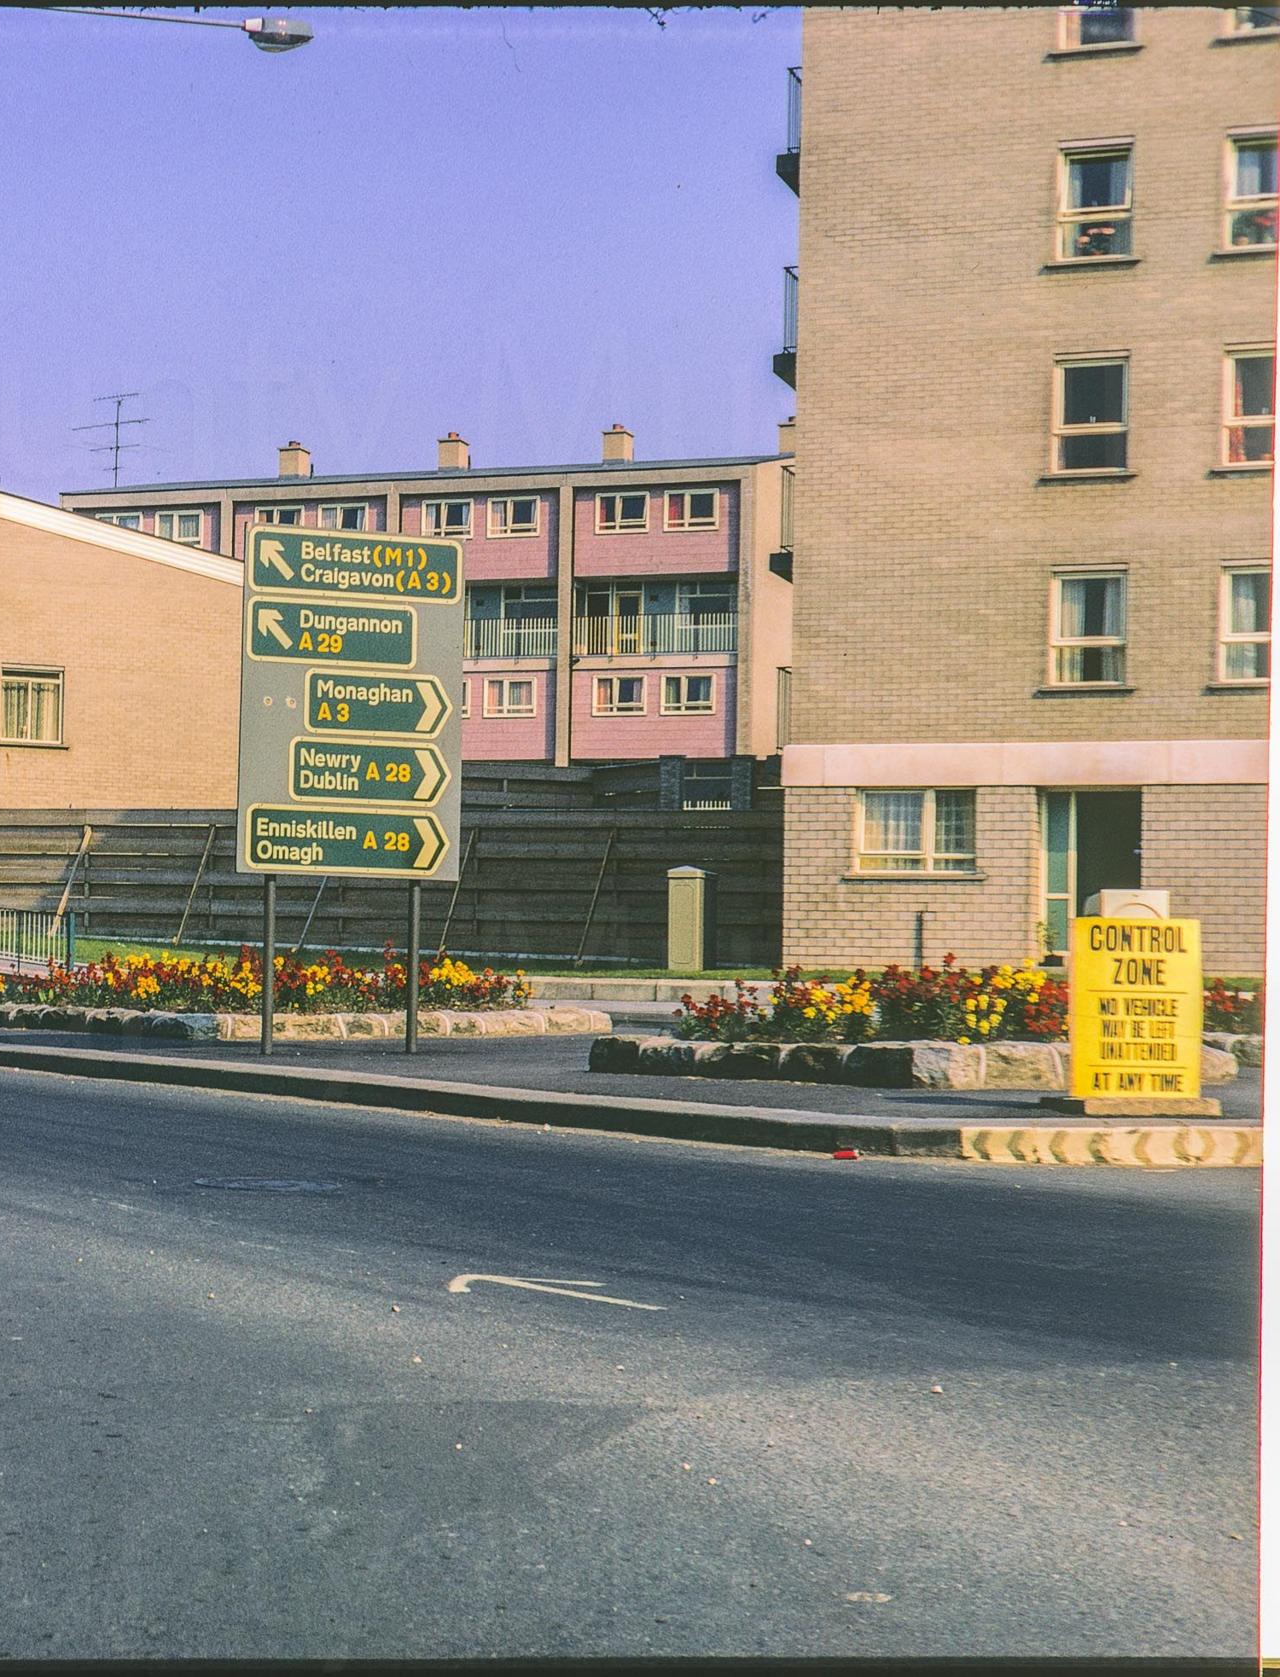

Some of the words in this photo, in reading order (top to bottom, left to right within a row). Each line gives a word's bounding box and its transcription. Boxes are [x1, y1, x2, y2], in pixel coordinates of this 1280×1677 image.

[301, 541, 371, 564] Belfast
[301, 563, 394, 589] Craigavon
[300, 609, 402, 635] Dungannon
[317, 679, 413, 706] Monaghan
[300, 748, 361, 773] Newry
[300, 770, 359, 791] Dublin
[256, 817, 357, 840] Enniskillen
[256, 840, 323, 865] Omagh
[1090, 924, 1187, 953] CONTROL
[1113, 958, 1167, 986] ZONE
[1099, 998, 1118, 1016] NO
[1124, 998, 1178, 1017] VEHICLE
[1102, 1020, 1125, 1038] MAY
[1132, 1020, 1145, 1038] BE
[1150, 1020, 1176, 1038] LEFT
[1099, 1041, 1178, 1061] UNATTENDED
[1093, 1072, 1111, 1091] AT
[1119, 1072, 1144, 1091] ANY
[1150, 1073, 1184, 1093] TIME
